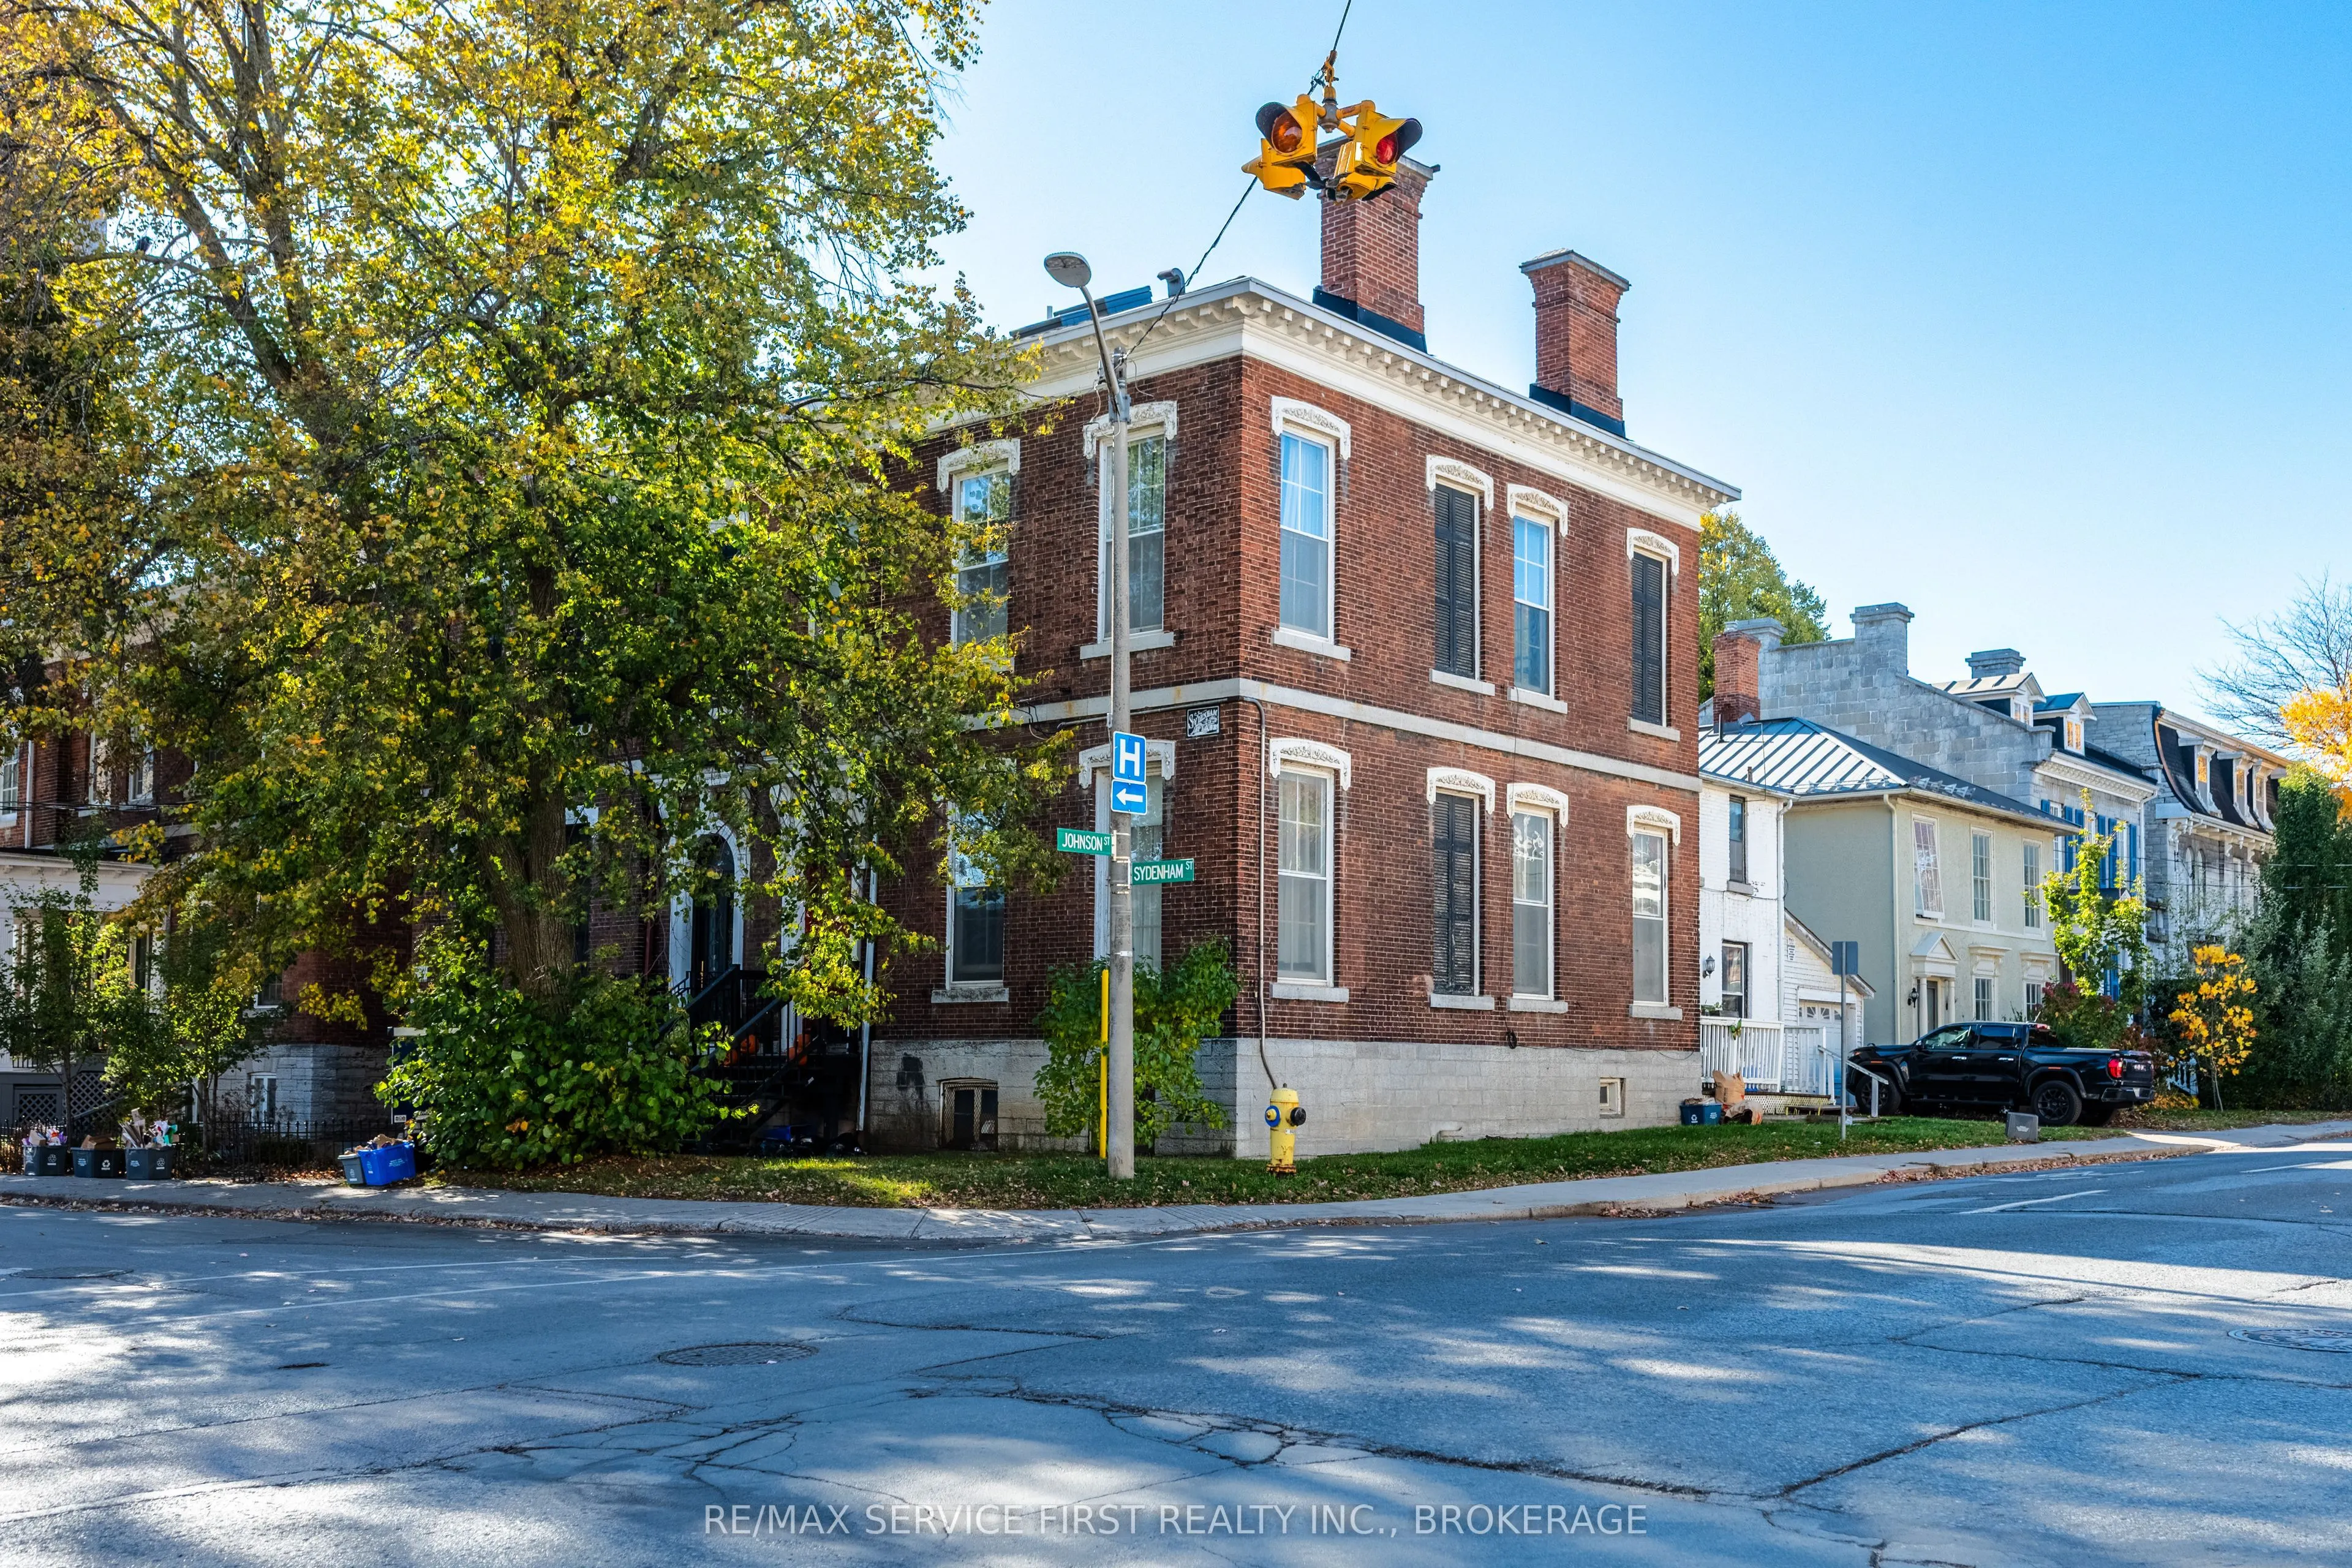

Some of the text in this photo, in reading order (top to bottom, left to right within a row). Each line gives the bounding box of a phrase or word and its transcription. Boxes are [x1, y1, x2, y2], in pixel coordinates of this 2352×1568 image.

[1120, 739, 1140, 777] H
[1062, 832, 1110, 851] JOHNSON ST
[1134, 861, 1193, 881] SYDENHAM ST
